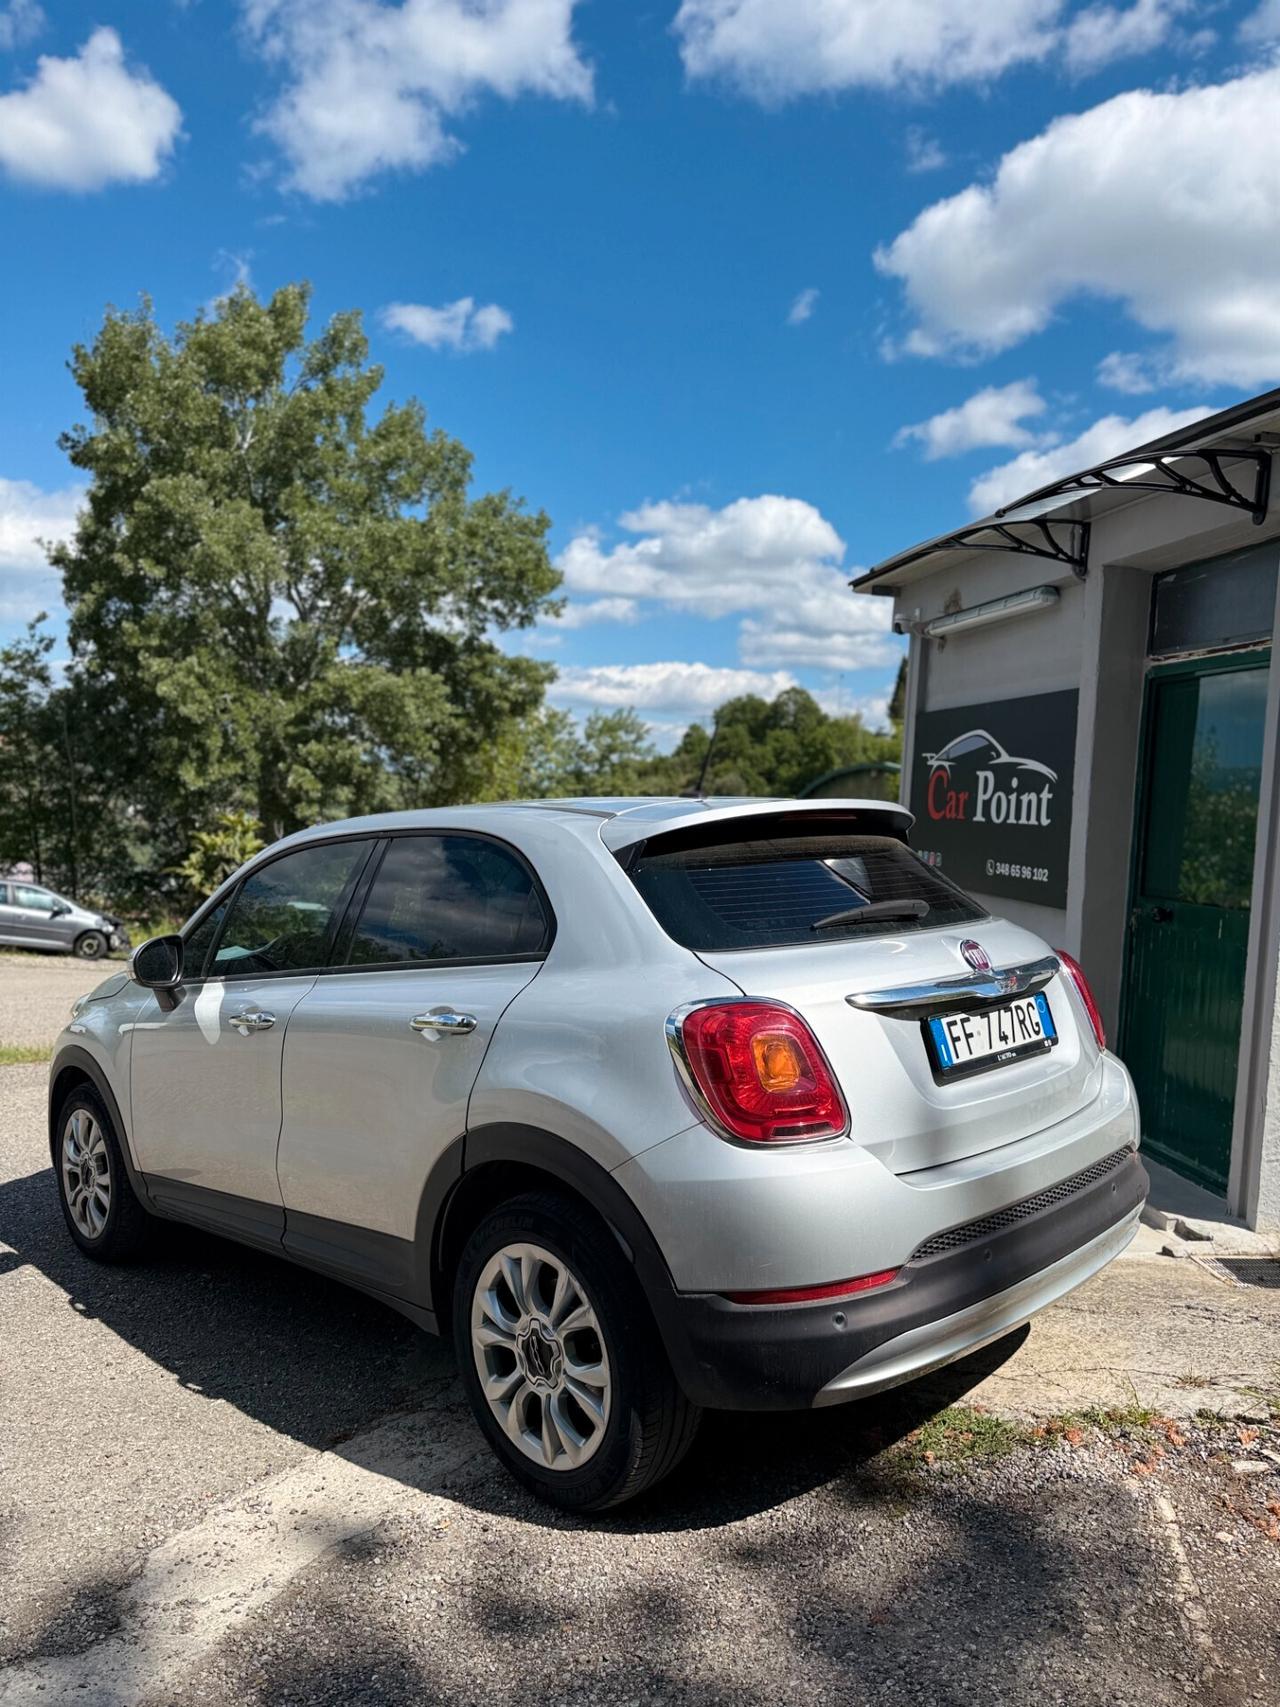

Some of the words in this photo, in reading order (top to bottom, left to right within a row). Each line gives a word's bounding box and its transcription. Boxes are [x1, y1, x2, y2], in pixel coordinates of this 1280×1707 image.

[927, 770, 969, 820] Car
[972, 770, 1053, 826] Point
[995, 862, 1010, 876] 348
[1011, 864, 1021, 878] 65
[1022, 865, 1032, 880] 96
[1033, 867, 1048, 881] 102
[946, 1017, 974, 1058] FF
